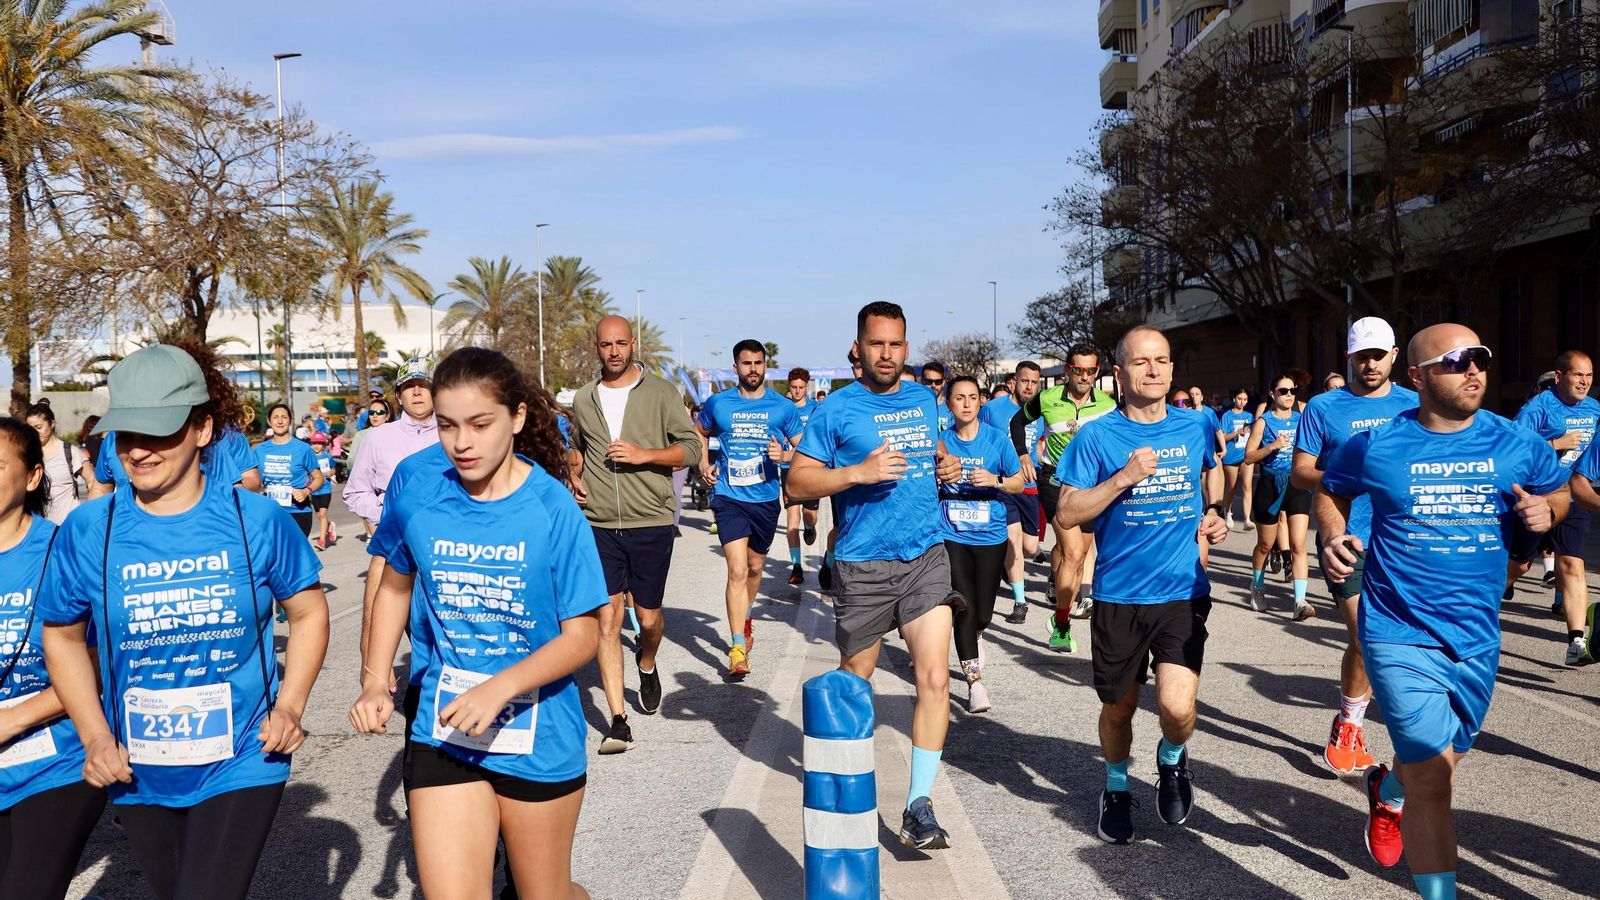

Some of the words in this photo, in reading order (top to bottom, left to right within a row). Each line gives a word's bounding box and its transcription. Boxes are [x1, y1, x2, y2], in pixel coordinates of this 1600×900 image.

[732, 412, 769, 420] mayoral
[873, 407, 924, 423] mayoral
[1565, 416, 1594, 425] mayoral
[878, 425, 928, 438] RUNNING
[735, 466, 757, 477] 2657
[1410, 458, 1495, 478] mayoral
[1410, 484, 1494, 495] RUNNING
[1418, 494, 1487, 505] MAKES
[958, 510, 979, 521] 836
[434, 540, 526, 563] mayoral
[123, 550, 229, 582] mayoral
[431, 570, 522, 589] RUNNING
[124, 584, 231, 609] RUNNING
[440, 583, 514, 601] MAKES
[134, 597, 224, 622] MAKES
[142, 711, 209, 738] 2347
